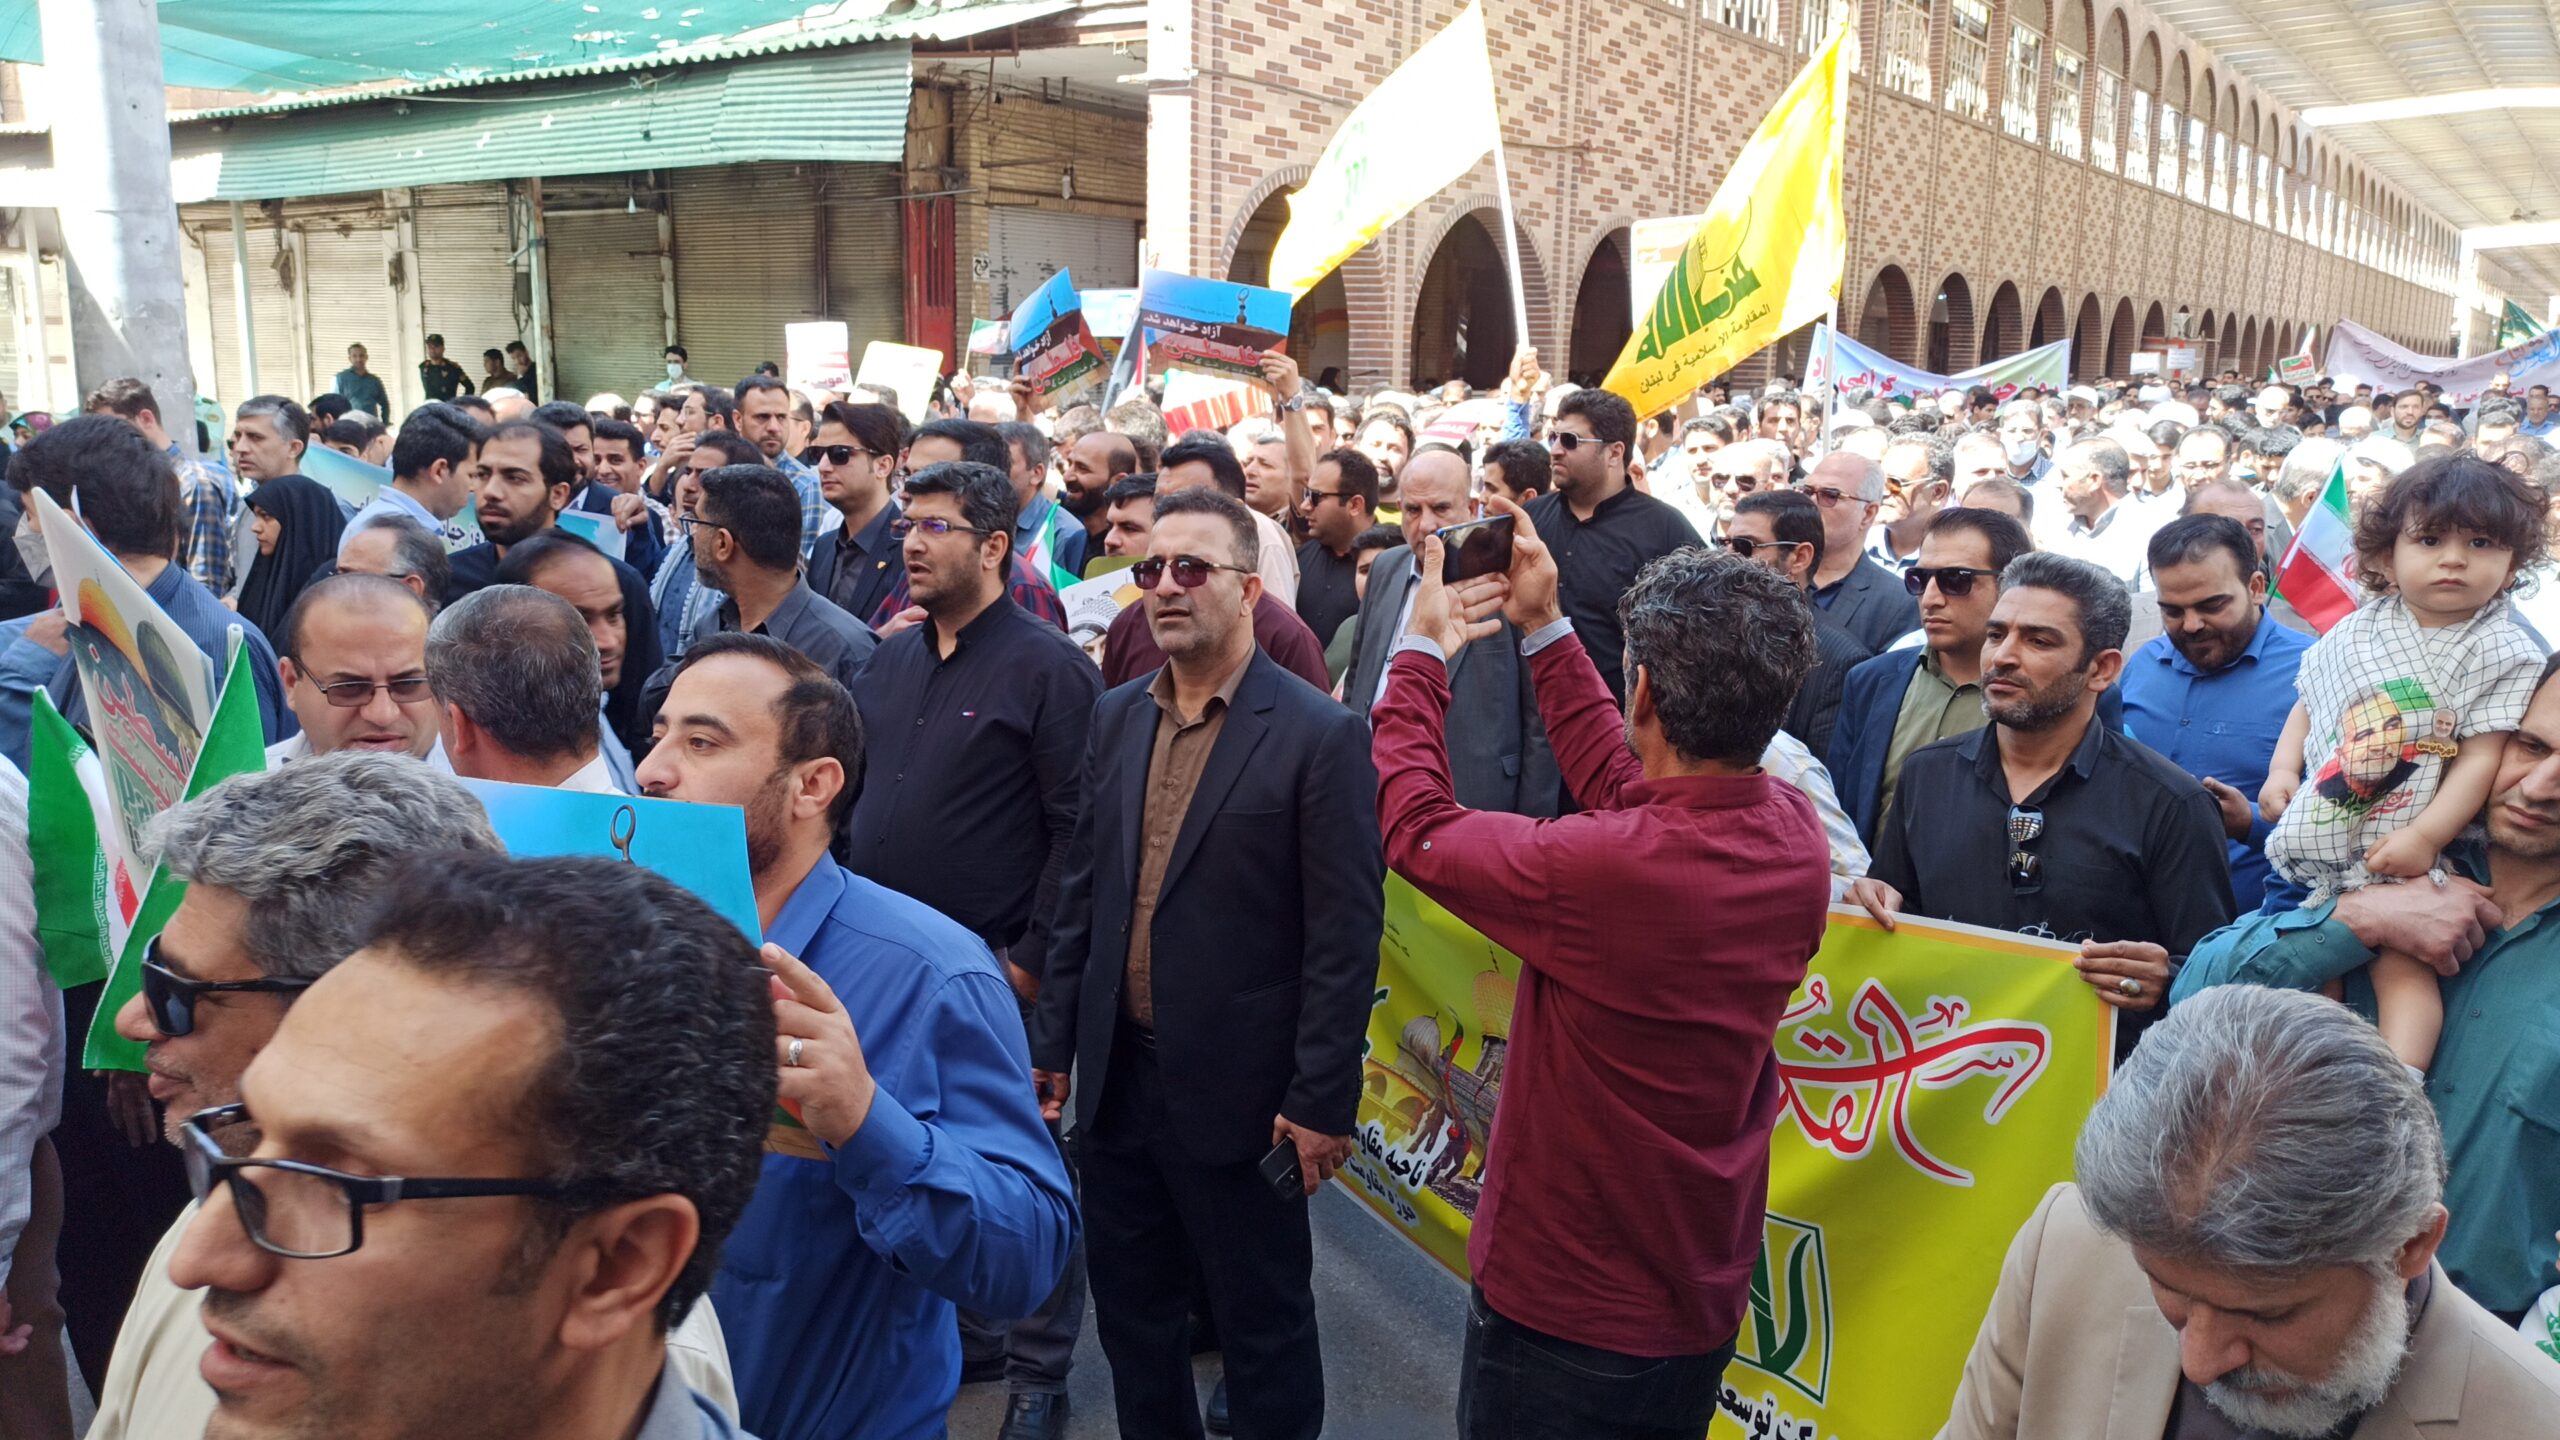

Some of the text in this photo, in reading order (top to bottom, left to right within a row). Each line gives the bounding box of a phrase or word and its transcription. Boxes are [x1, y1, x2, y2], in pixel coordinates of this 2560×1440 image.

[1163, 318, 1198, 334] خواهد
[1201, 325, 1222, 339] آزاد
[1639, 370, 1664, 394] لبنان
[1352, 1126, 1426, 1187] ناحیه مقاوم
